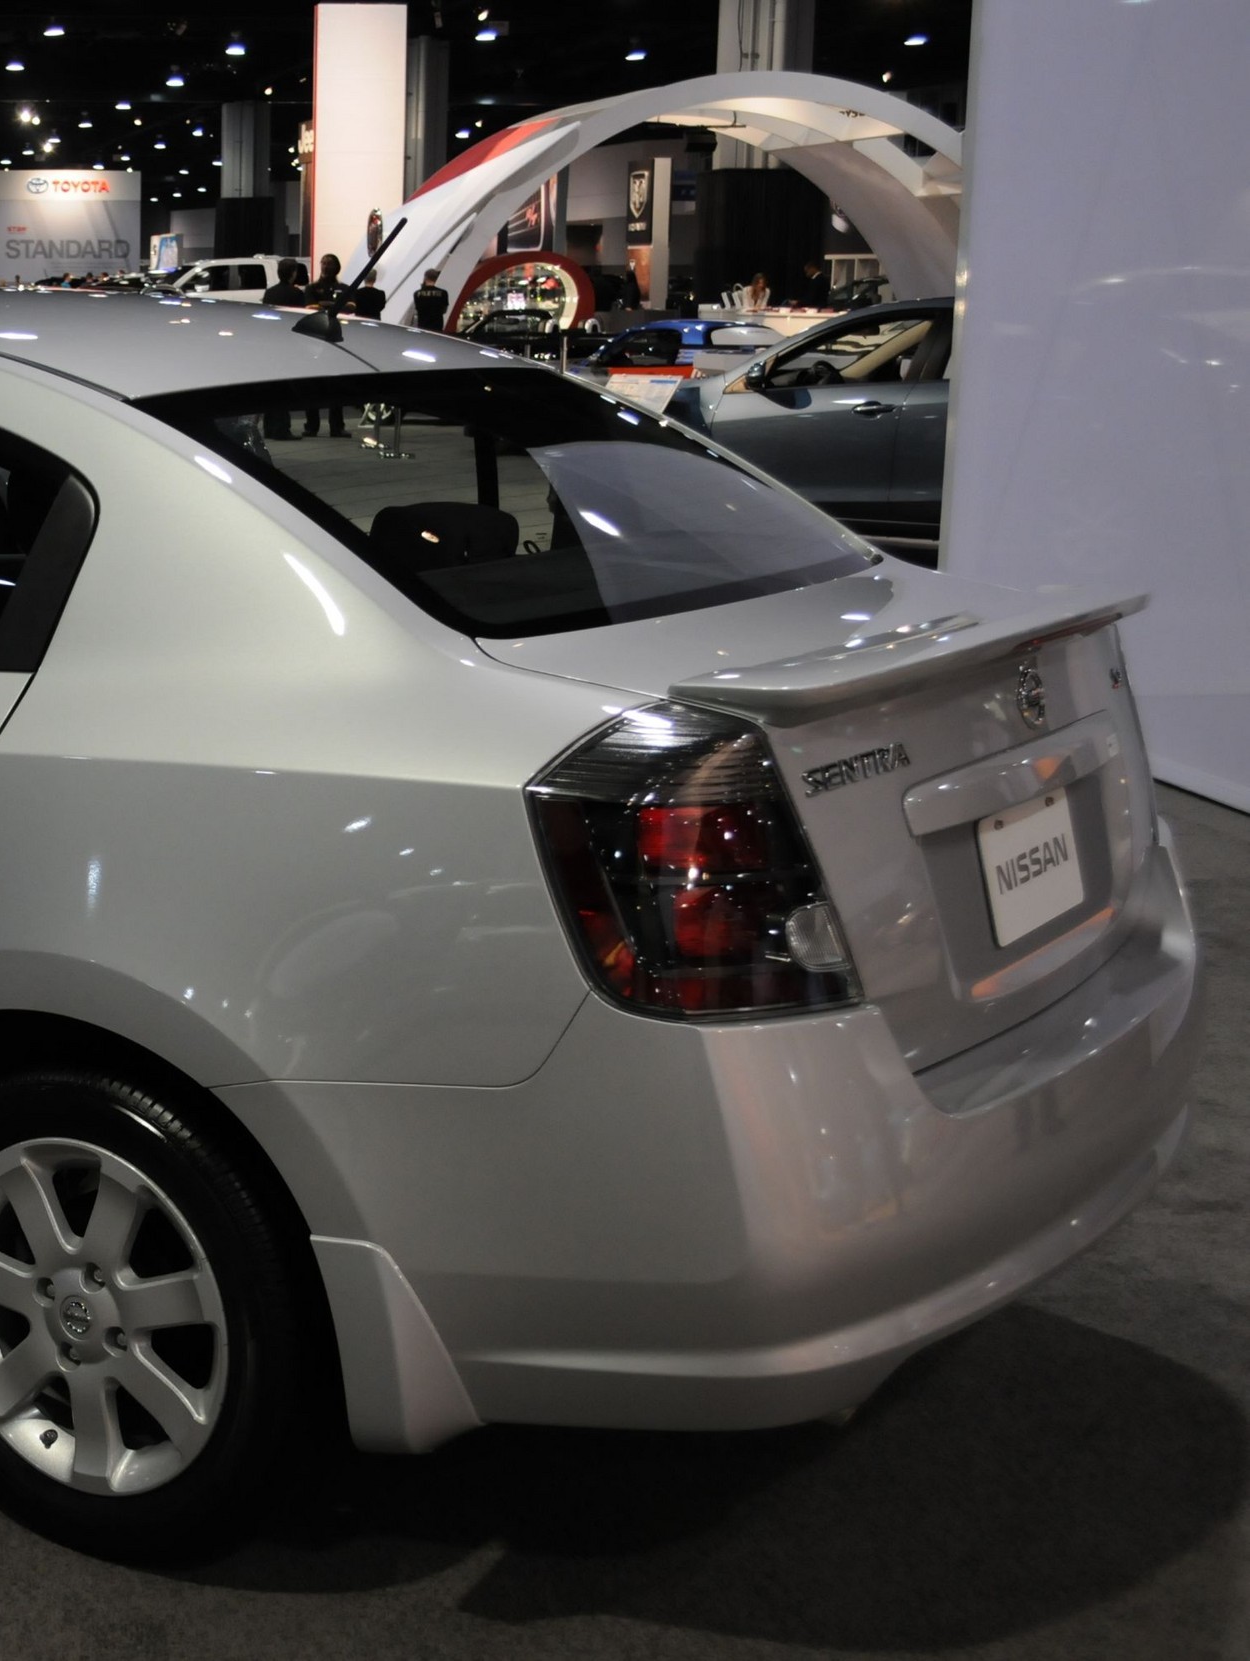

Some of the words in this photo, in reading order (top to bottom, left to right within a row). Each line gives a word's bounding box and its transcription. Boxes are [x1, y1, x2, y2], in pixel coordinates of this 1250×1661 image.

[52, 180, 110, 193] TOYOTA
[5, 240, 130, 260] STANDARD
[801, 742, 911, 798] SENTRA
[996, 833, 1069, 895] NISSAN
